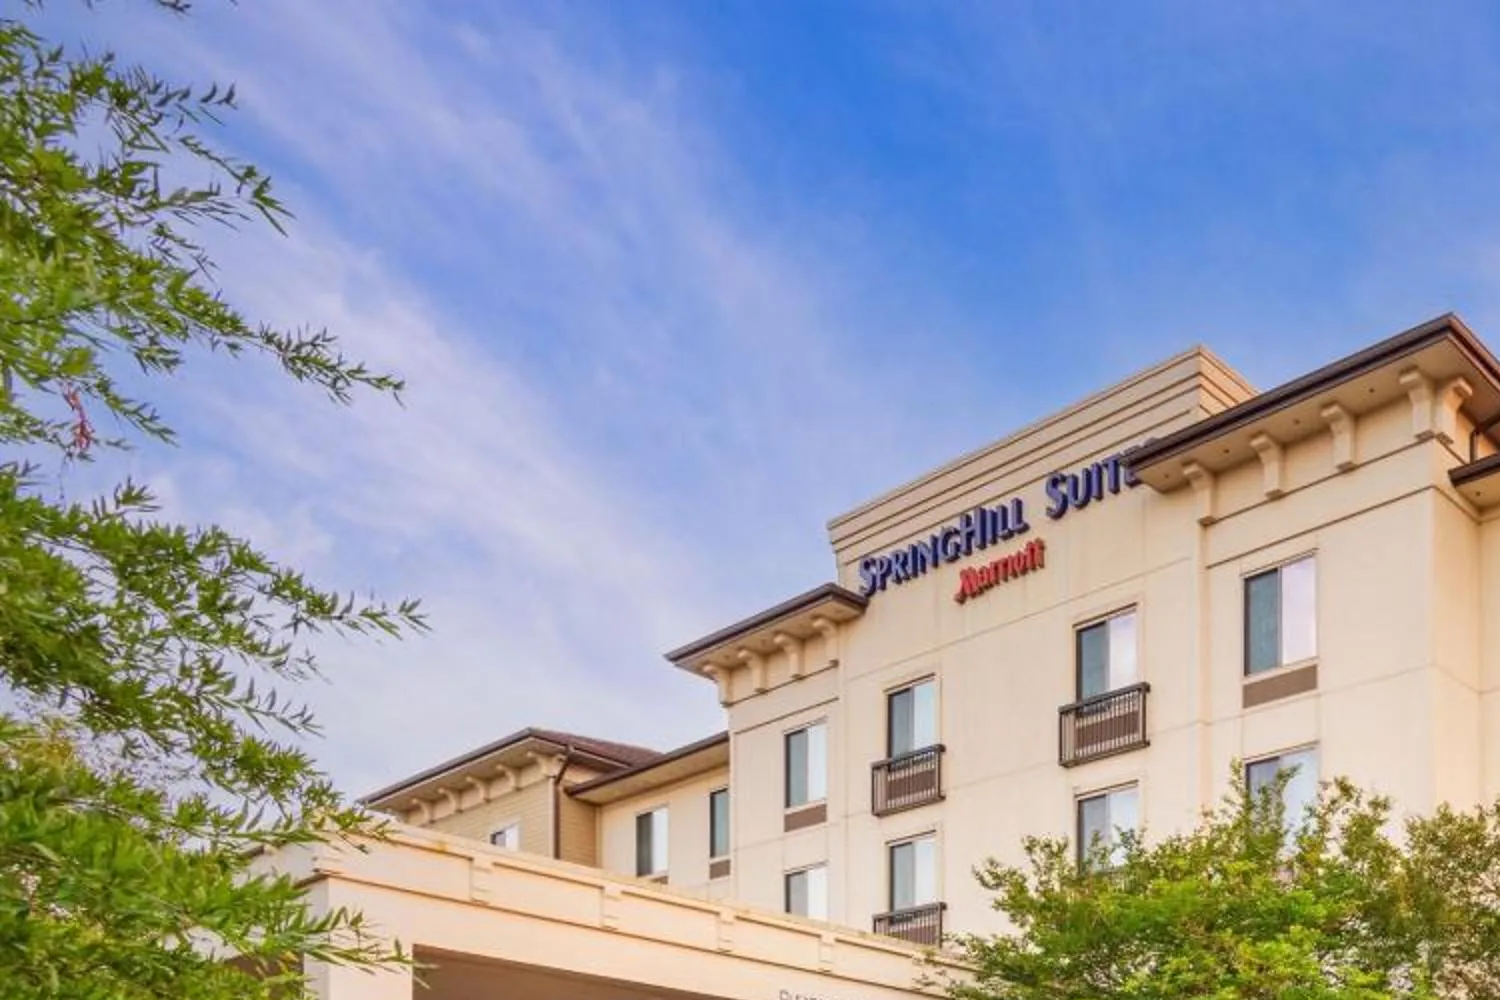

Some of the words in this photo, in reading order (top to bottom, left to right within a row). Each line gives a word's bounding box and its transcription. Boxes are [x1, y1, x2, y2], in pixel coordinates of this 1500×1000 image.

[859, 497, 1030, 597] SPRINGHILL
[1045, 447, 1146, 520] SUIT
[954, 537, 1046, 604] Marriott
